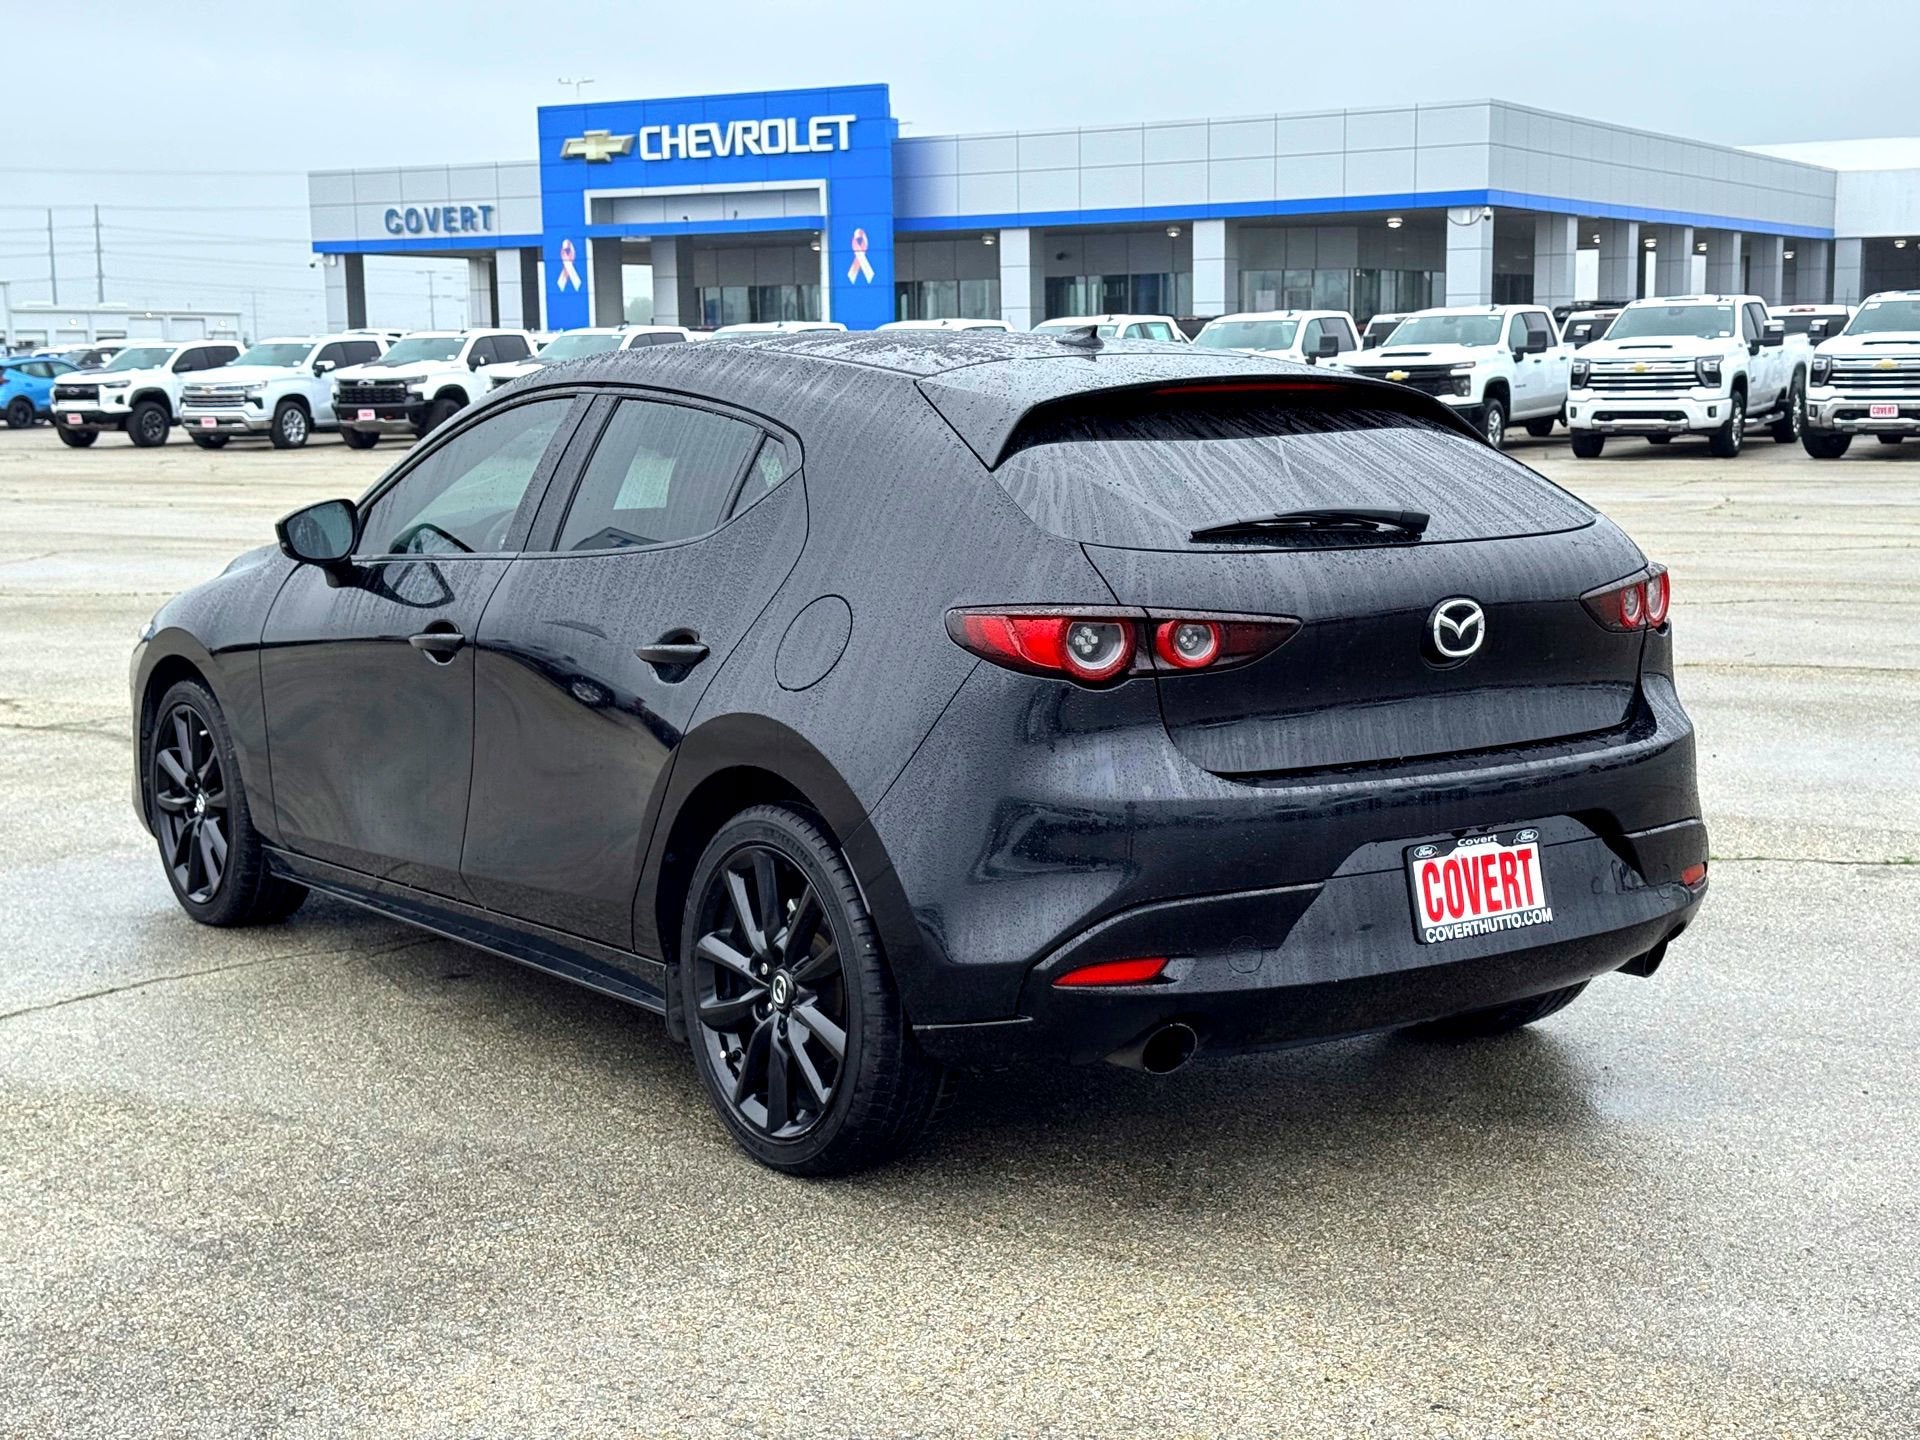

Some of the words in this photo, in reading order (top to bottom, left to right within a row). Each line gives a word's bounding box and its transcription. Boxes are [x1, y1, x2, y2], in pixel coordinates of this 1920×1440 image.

[639, 114, 857, 161] CHEVROLET
[384, 205, 494, 235] COVERT
[1457, 834, 1498, 847] Covert
[1422, 849, 1535, 923] COVERT
[1425, 908, 1553, 943] COVERTHUTTO.COM
